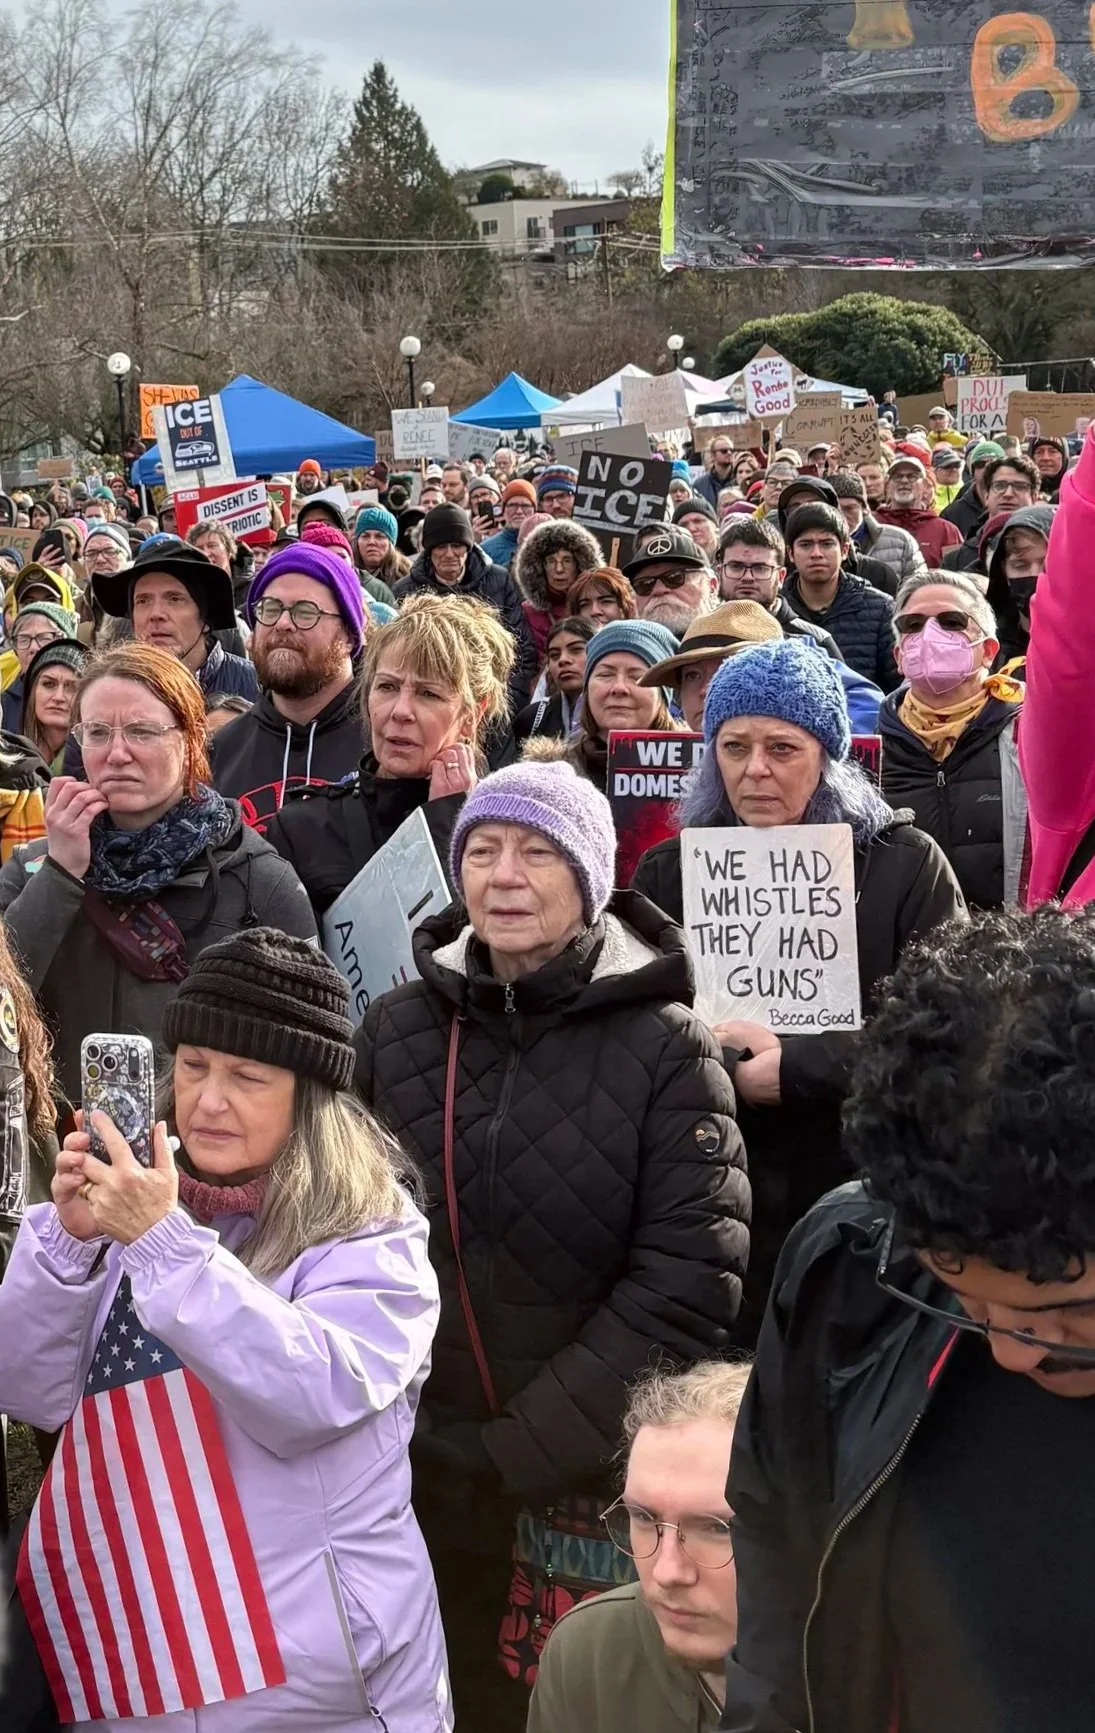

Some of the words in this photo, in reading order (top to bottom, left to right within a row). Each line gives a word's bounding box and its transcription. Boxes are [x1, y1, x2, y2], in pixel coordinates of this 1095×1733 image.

[143, 386, 170, 406] SHE
[754, 393, 790, 415] Good
[166, 399, 212, 428] ICE
[860, 413, 874, 422] ALL
[961, 414, 988, 429] FOR
[180, 428, 194, 439] OUT
[194, 426, 203, 437] OF
[175, 455, 218, 467] SEATTLE
[587, 455, 644, 487] NO
[203, 492, 244, 518] DISSENT
[248, 489, 258, 502] IS
[573, 484, 665, 526] ICE
[226, 512, 262, 533] TRIOTIC
[637, 741, 682, 767] WE
[770, 848, 831, 884] HAD
[702, 886, 842, 917] WHISTLES
[691, 921, 762, 957] THEY
[779, 926, 839, 961] HAD
[335, 920, 371, 1016] Ame
[769, 1009, 816, 1026] Becca
[817, 1009, 855, 1027] Good
